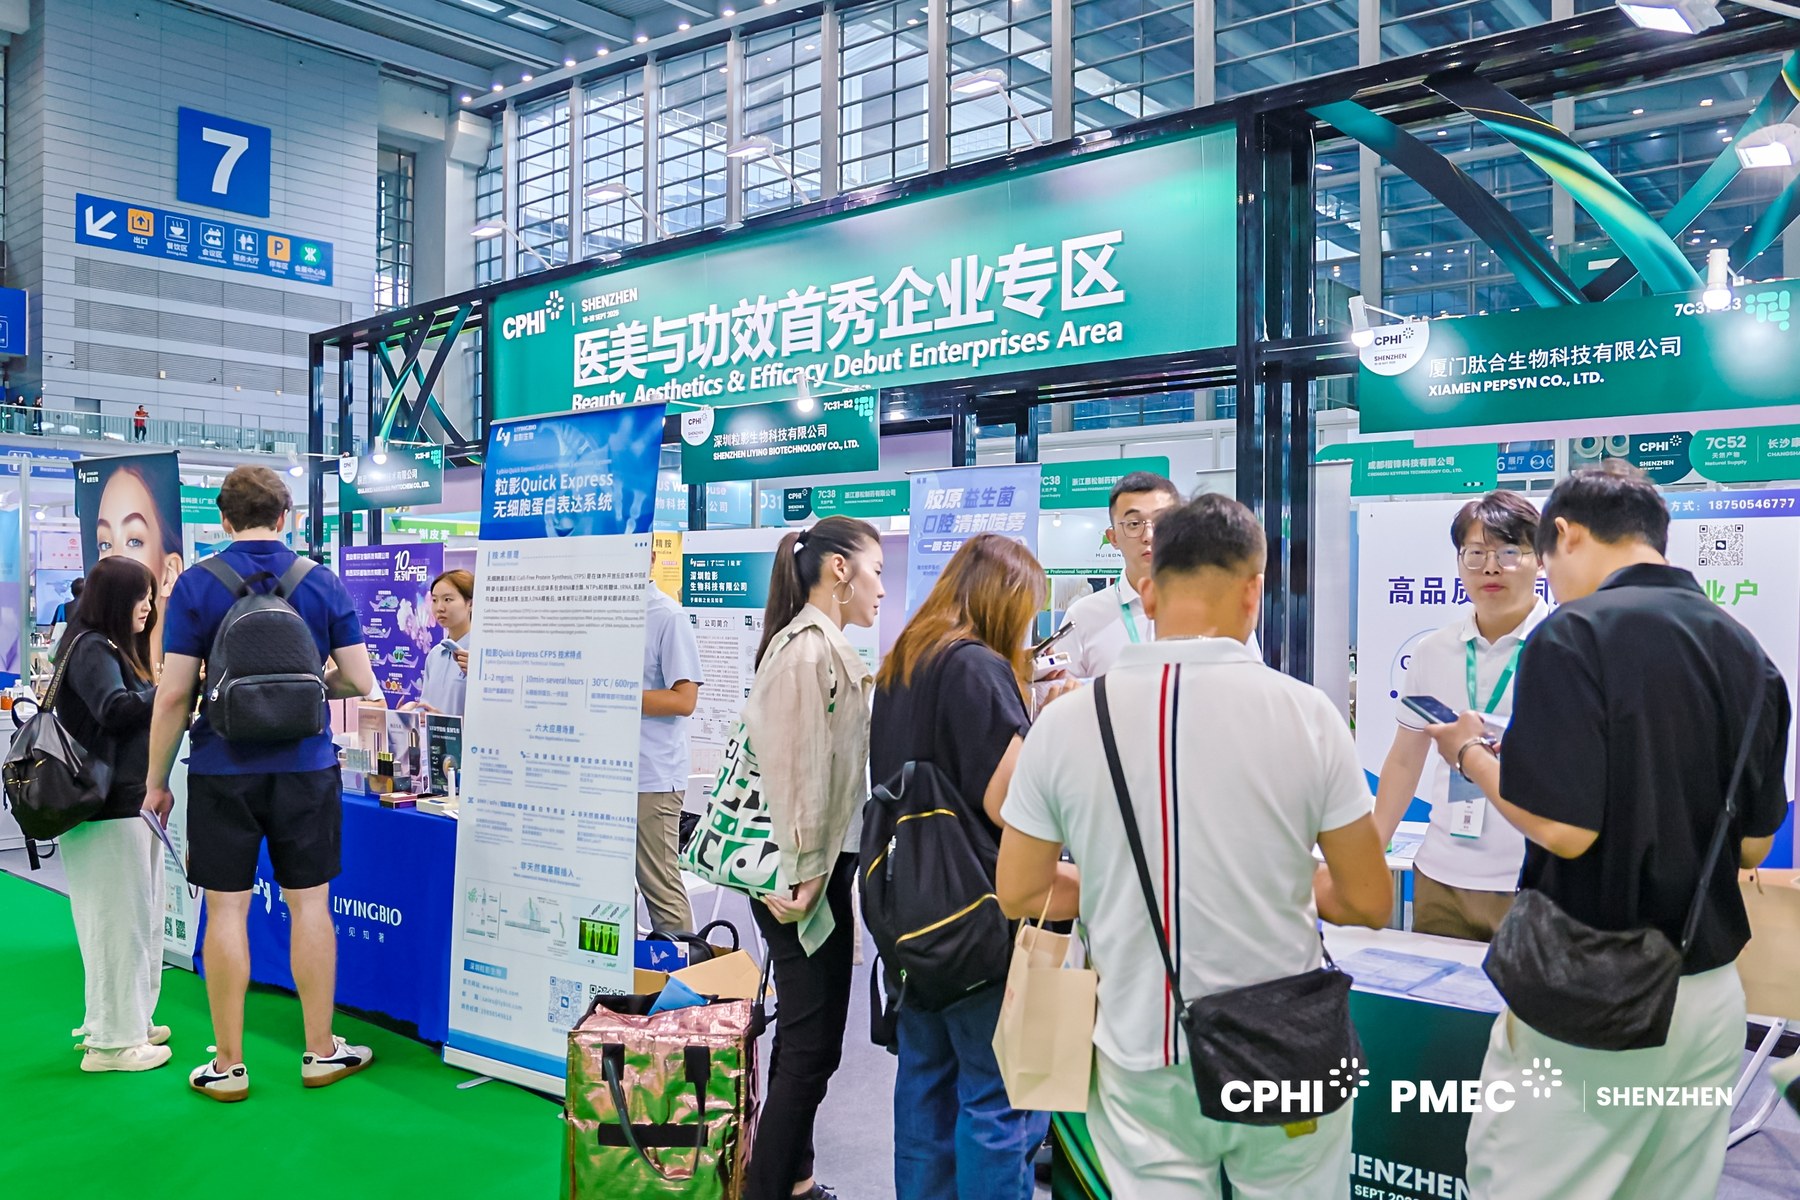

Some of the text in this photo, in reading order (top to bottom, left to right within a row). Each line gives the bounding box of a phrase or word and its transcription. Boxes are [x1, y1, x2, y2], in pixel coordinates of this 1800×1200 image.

[203, 127, 249, 195] 7
[133, 236, 148, 246] 出口
[166, 242, 188, 253] 餐饮区
[274, 240, 284, 255] P
[581, 288, 638, 312] SHENZHEN
[1674, 297, 1742, 317] 7C33
[573, 230, 1125, 388] 医美与功效首秀企业专区
[503, 309, 546, 340] CPHI
[1374, 335, 1402, 346] CPHI
[1374, 353, 1407, 362] SHENZHEN
[1429, 335, 1681, 378] 厦门肽合生物科技有限公司
[572, 319, 1124, 410] Beauty Aesthetics & Efficacy Debut Enterprises Area
[1428, 371, 1605, 397] XIAMEN PEPSYN CO., LTD.
[823, 399, 853, 411] 7C31-B2
[688, 418, 702, 426] CPHI
[713, 423, 827, 448] 深圳粒影生物科技有限公司
[1705, 435, 1747, 450] 7C52
[713, 450, 746, 461] SHENZHEN
[768, 442, 827, 456] BIOTECHNOLOGY
[844, 439, 860, 449] LTD.
[1639, 441, 1669, 452] CPHI
[1496, 456, 1505, 471] 6
[1639, 459, 1674, 467] SHENZHEN
[495, 473, 614, 496] 粒影Quick Express
[788, 492, 802, 500] CPHI
[817, 489, 836, 499] 7C38
[493, 493, 613, 519] 无细胞蛋白表达系统
[923, 512, 1026, 534] 口腔清新喷雾
[394, 550, 410, 571] 10
[690, 581, 748, 592] 生物科技有限公司
[539, 650, 557, 659] CFPS
[567, 676, 584, 686] hours
[615, 679, 639, 690] 600rpm
[334, 895, 402, 927] LIYINGBIO
[1354, 1184, 1386, 1200] SEPT
